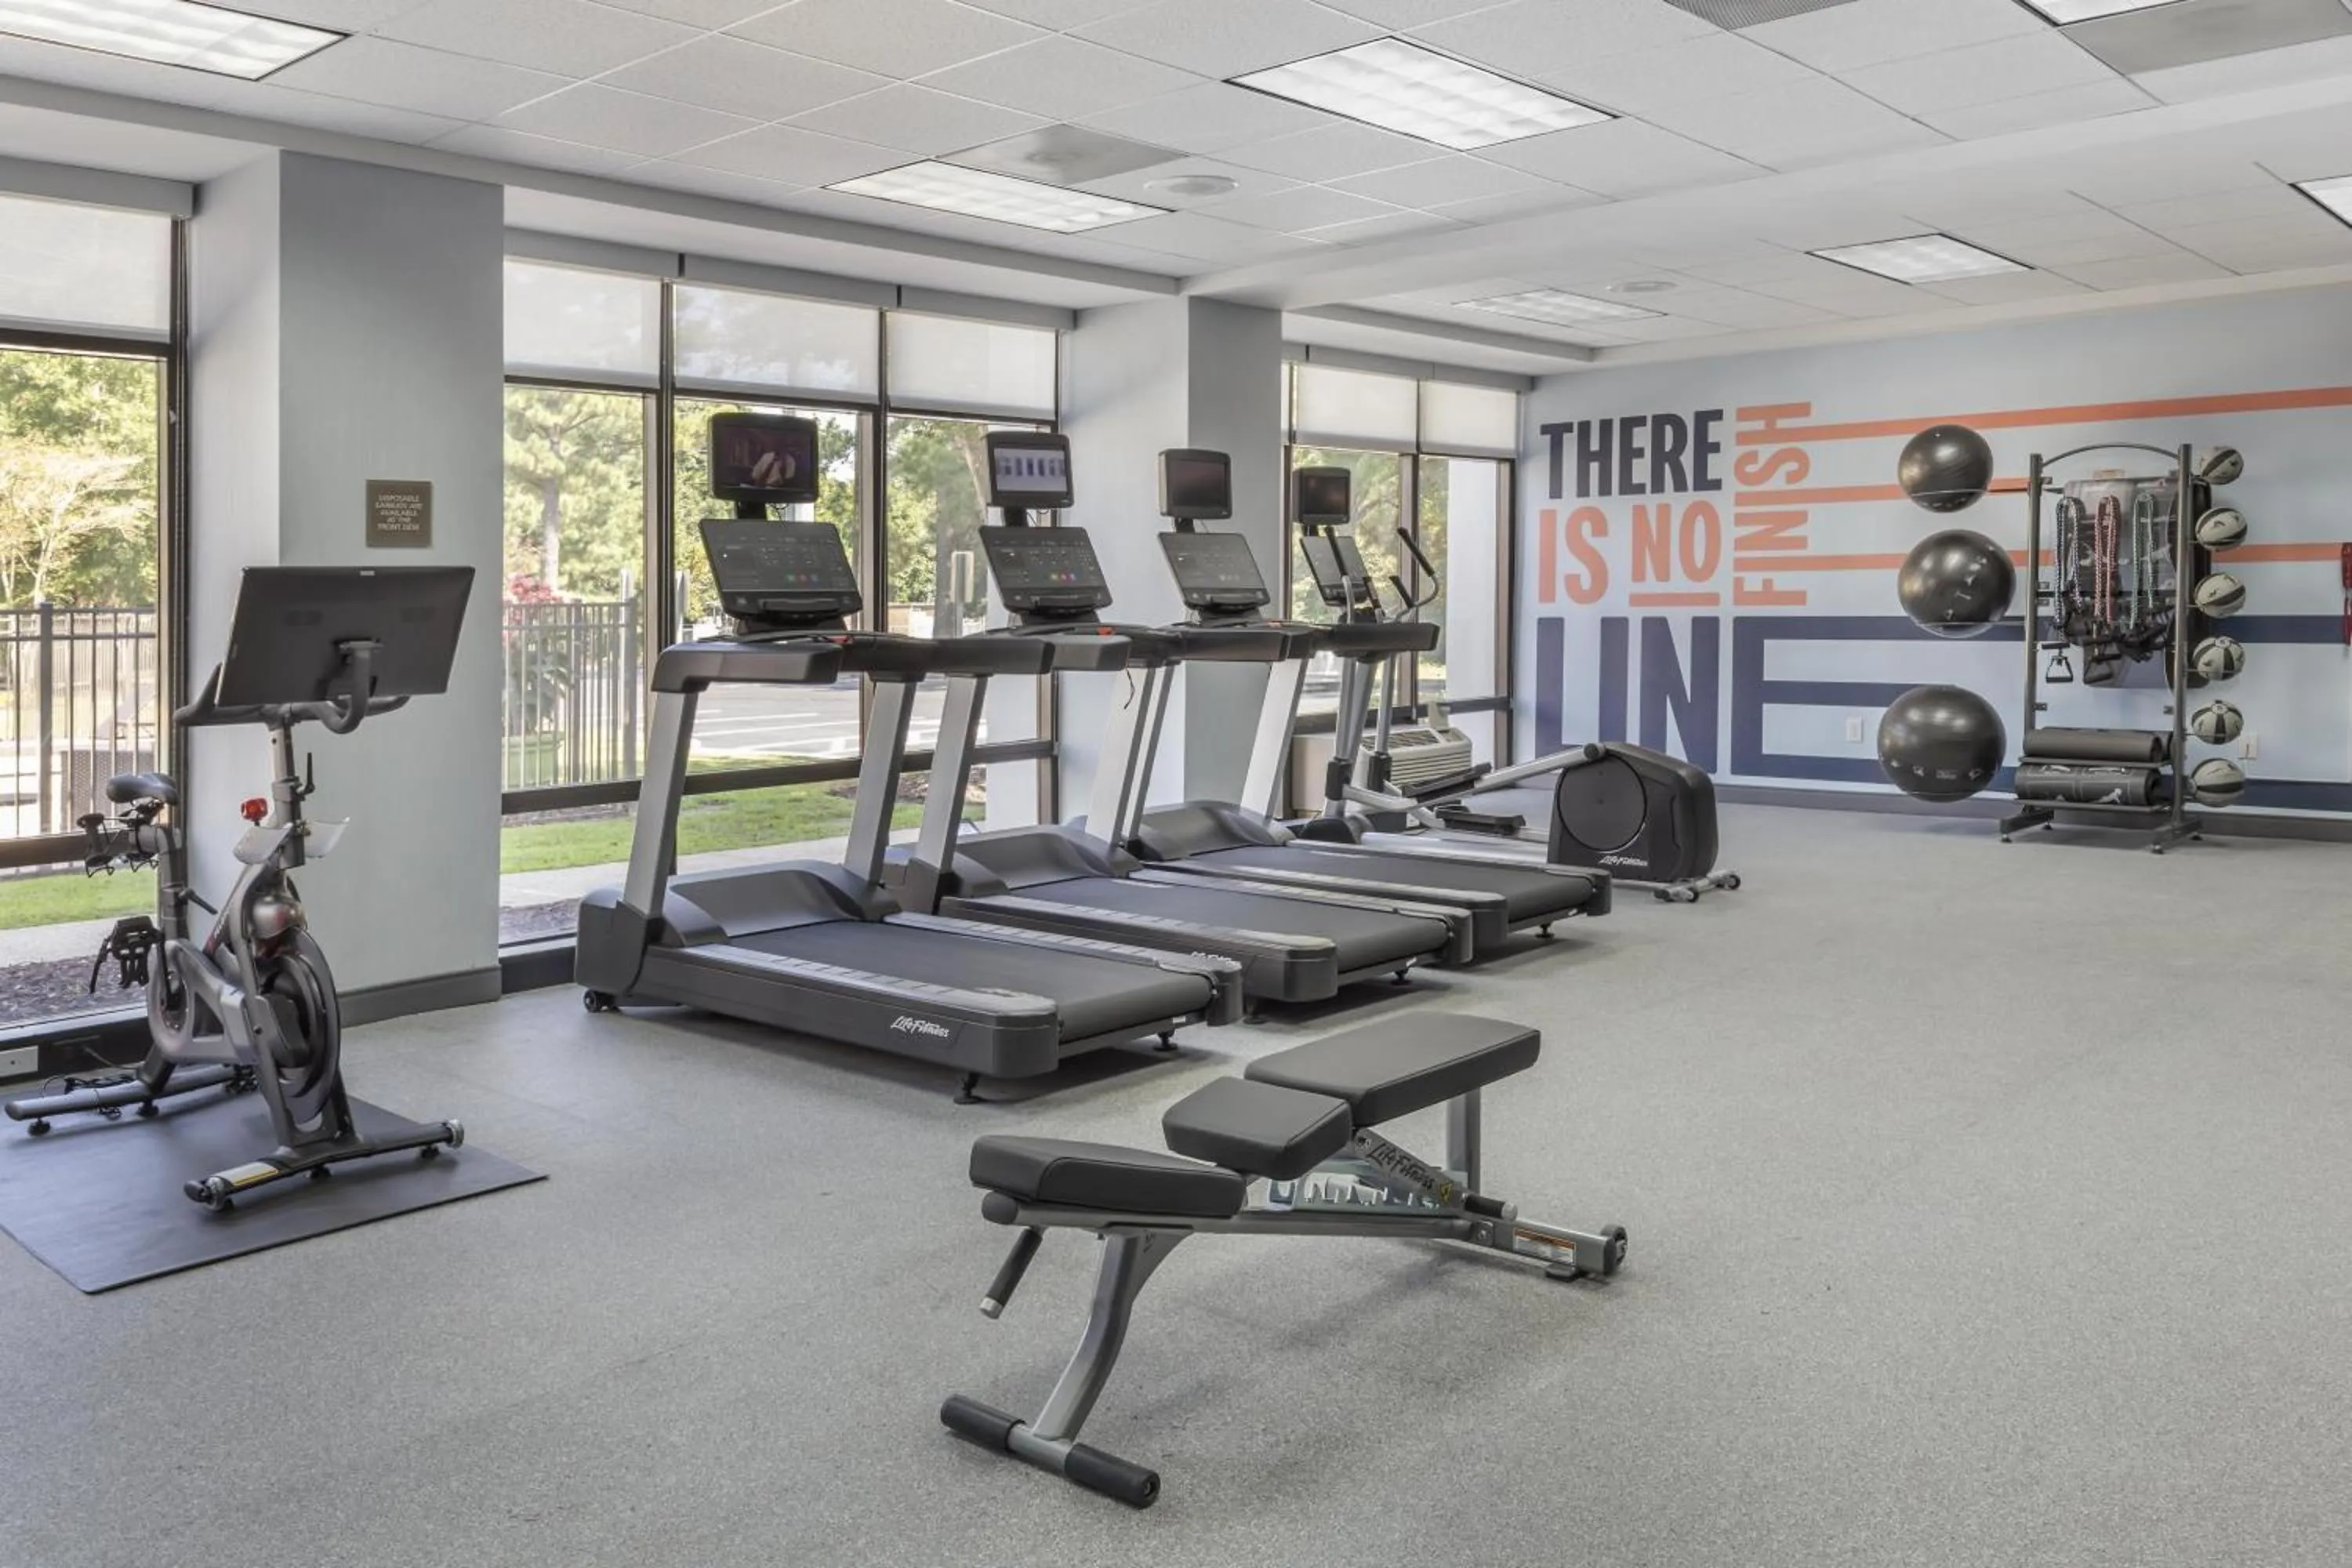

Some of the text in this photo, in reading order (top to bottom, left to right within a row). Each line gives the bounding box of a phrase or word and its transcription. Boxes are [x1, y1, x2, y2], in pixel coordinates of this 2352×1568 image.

[1540, 408, 1724, 499] THERE
[1733, 401, 1812, 607] FINISH
[1537, 499, 1722, 605] IS NO
[1534, 615, 1936, 785] LINE
